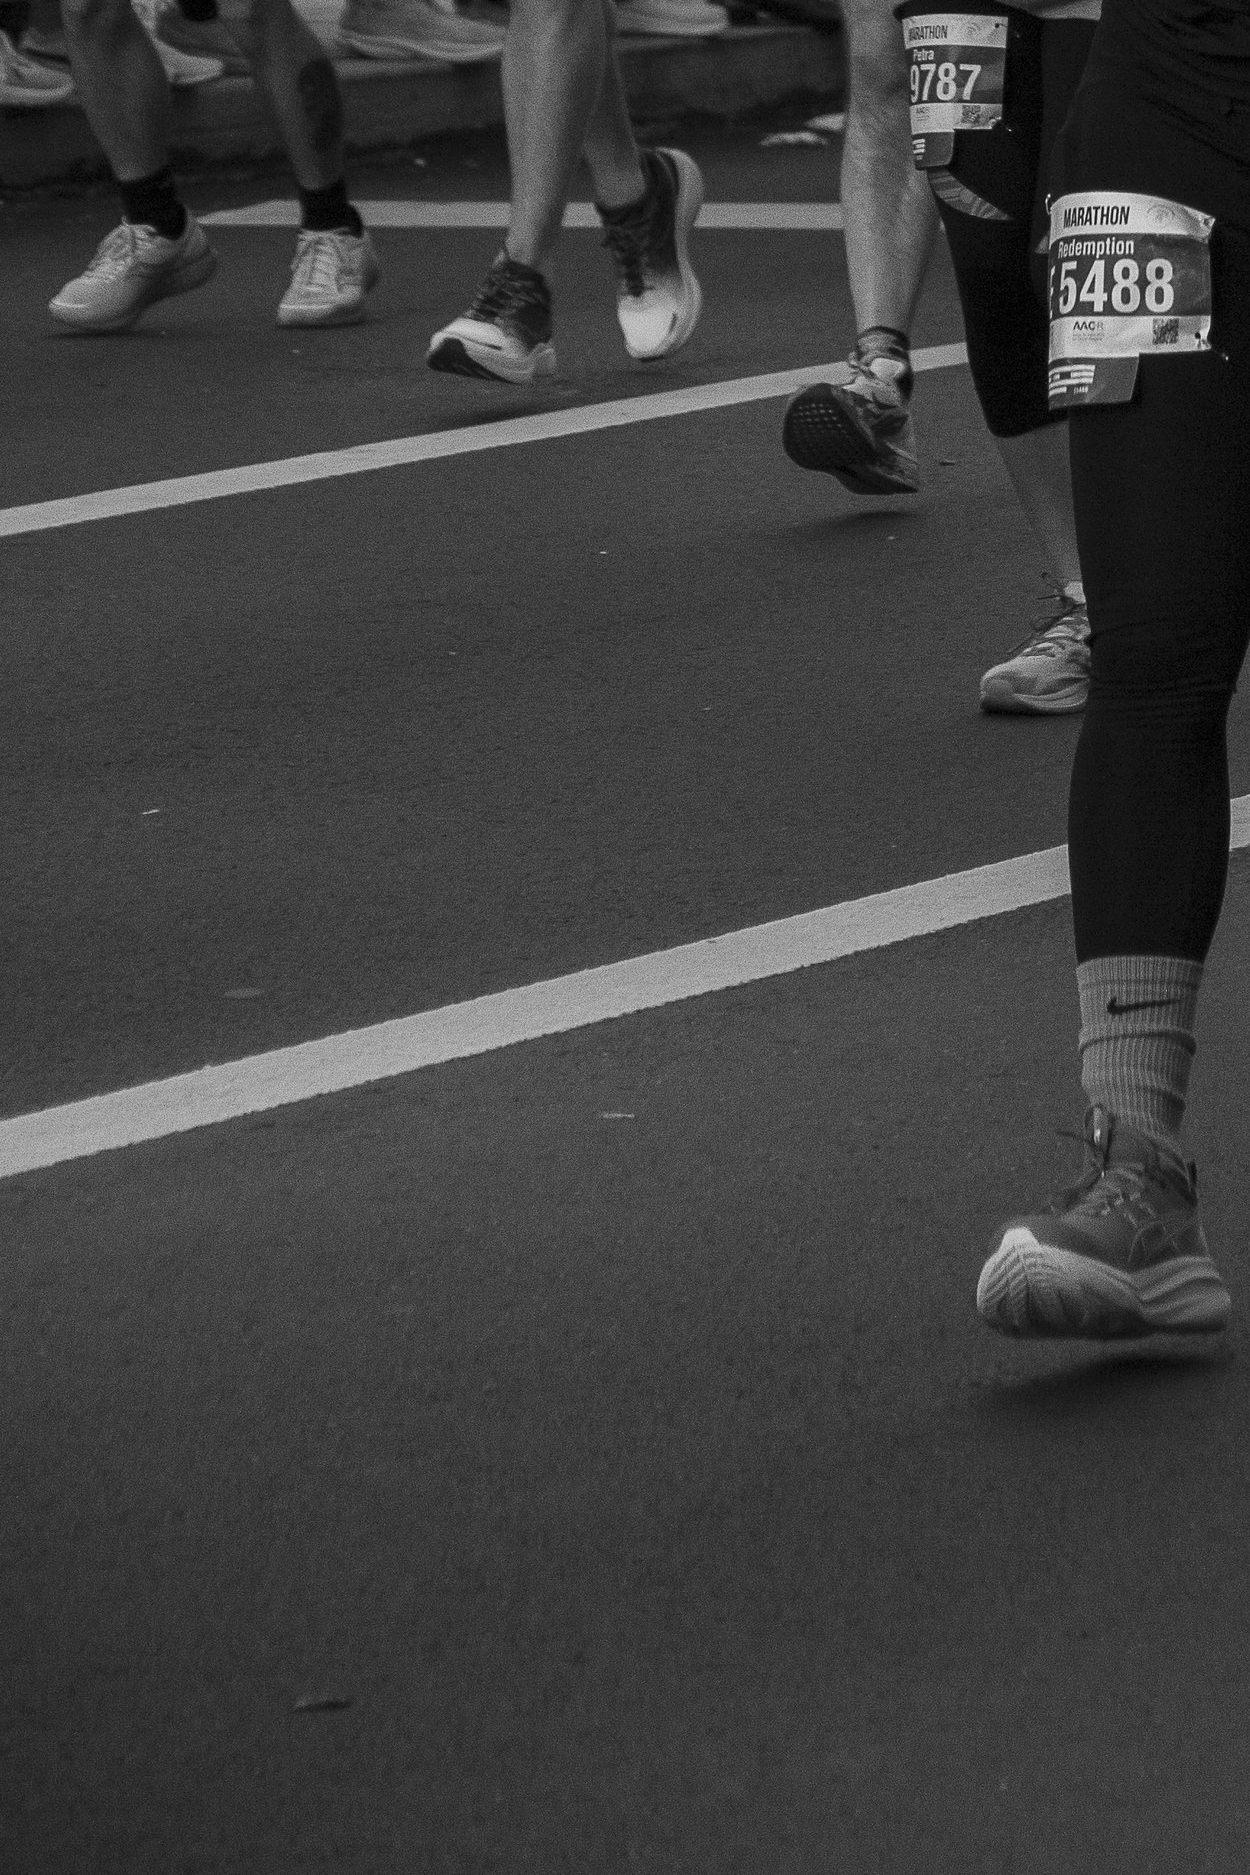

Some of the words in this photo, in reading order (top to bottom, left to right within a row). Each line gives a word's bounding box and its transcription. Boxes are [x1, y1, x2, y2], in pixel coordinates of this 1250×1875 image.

[913, 49, 935, 62] Petra
[910, 62, 982, 103] 9787
[1063, 206, 1130, 228] MARATHON
[1057, 237, 1135, 259] Redemption
[1059, 258, 1175, 314] 5488
